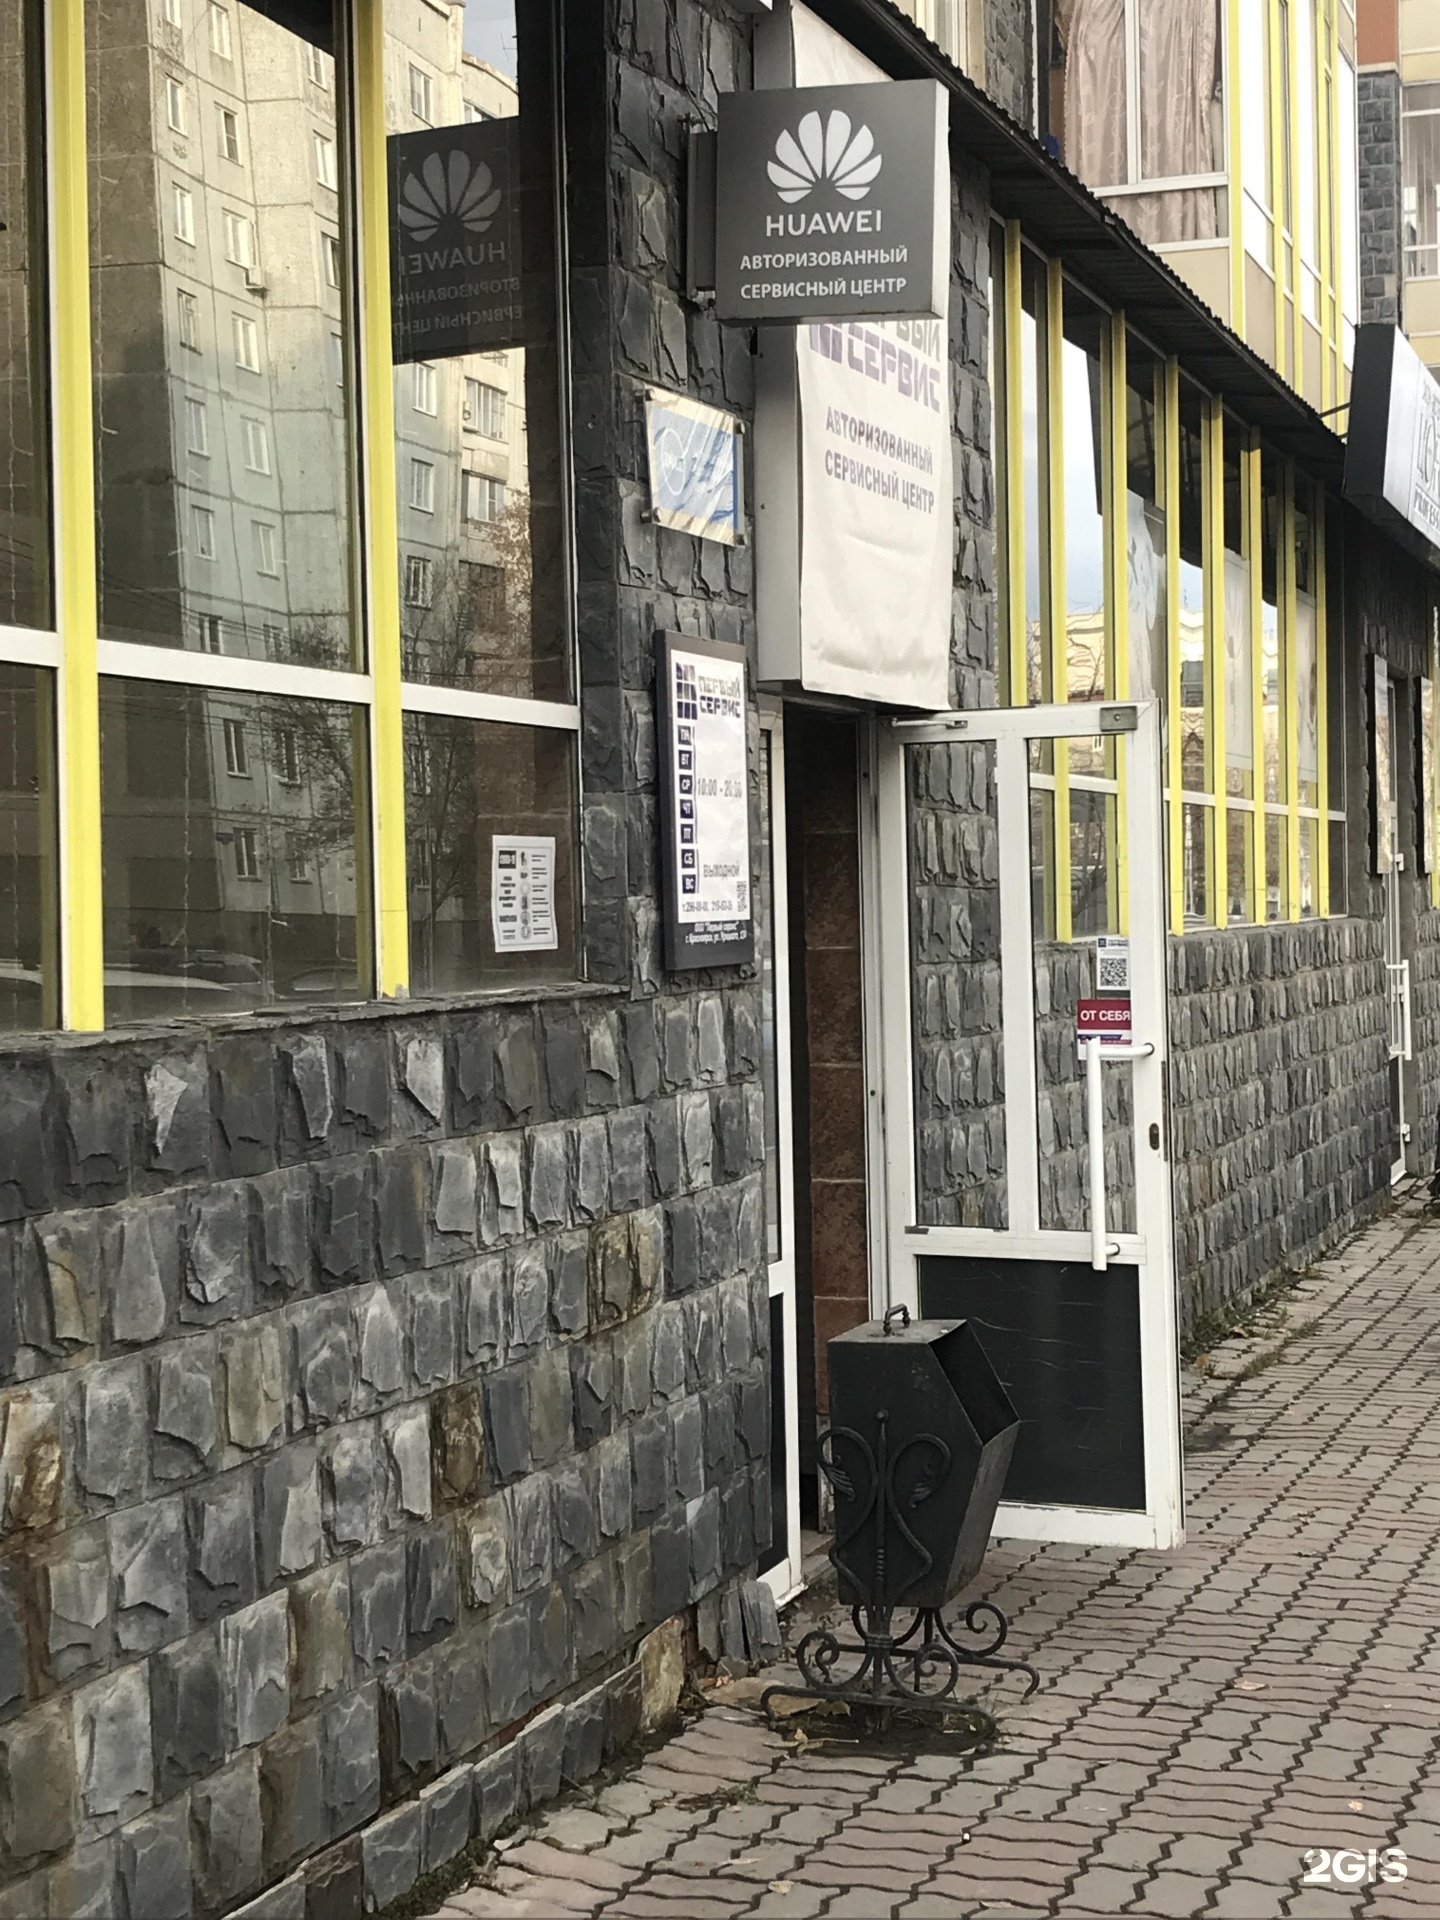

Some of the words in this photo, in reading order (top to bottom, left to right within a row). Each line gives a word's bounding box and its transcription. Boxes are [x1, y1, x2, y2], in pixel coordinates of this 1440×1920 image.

[766, 210, 882, 237] HUAWEI
[740, 245, 908, 270] АВТОРИЗОВАННЫЙ
[740, 277, 847, 300] СЕРВИСНЫЙ
[850, 277, 907, 298] ЦЕНТР
[847, 323, 941, 414] СЕРВИС
[825, 405, 934, 476] АВТОРИЗОВАННЫЙ
[824, 449, 900, 501] СЕРВИСНЫЙ
[902, 479, 935, 515] ЦЕНТР
[699, 695, 741, 719] СЕРВИС
[1080, 1010, 1097, 1021] ОТ
[1098, 1009, 1131, 1021] СЕБЯ
